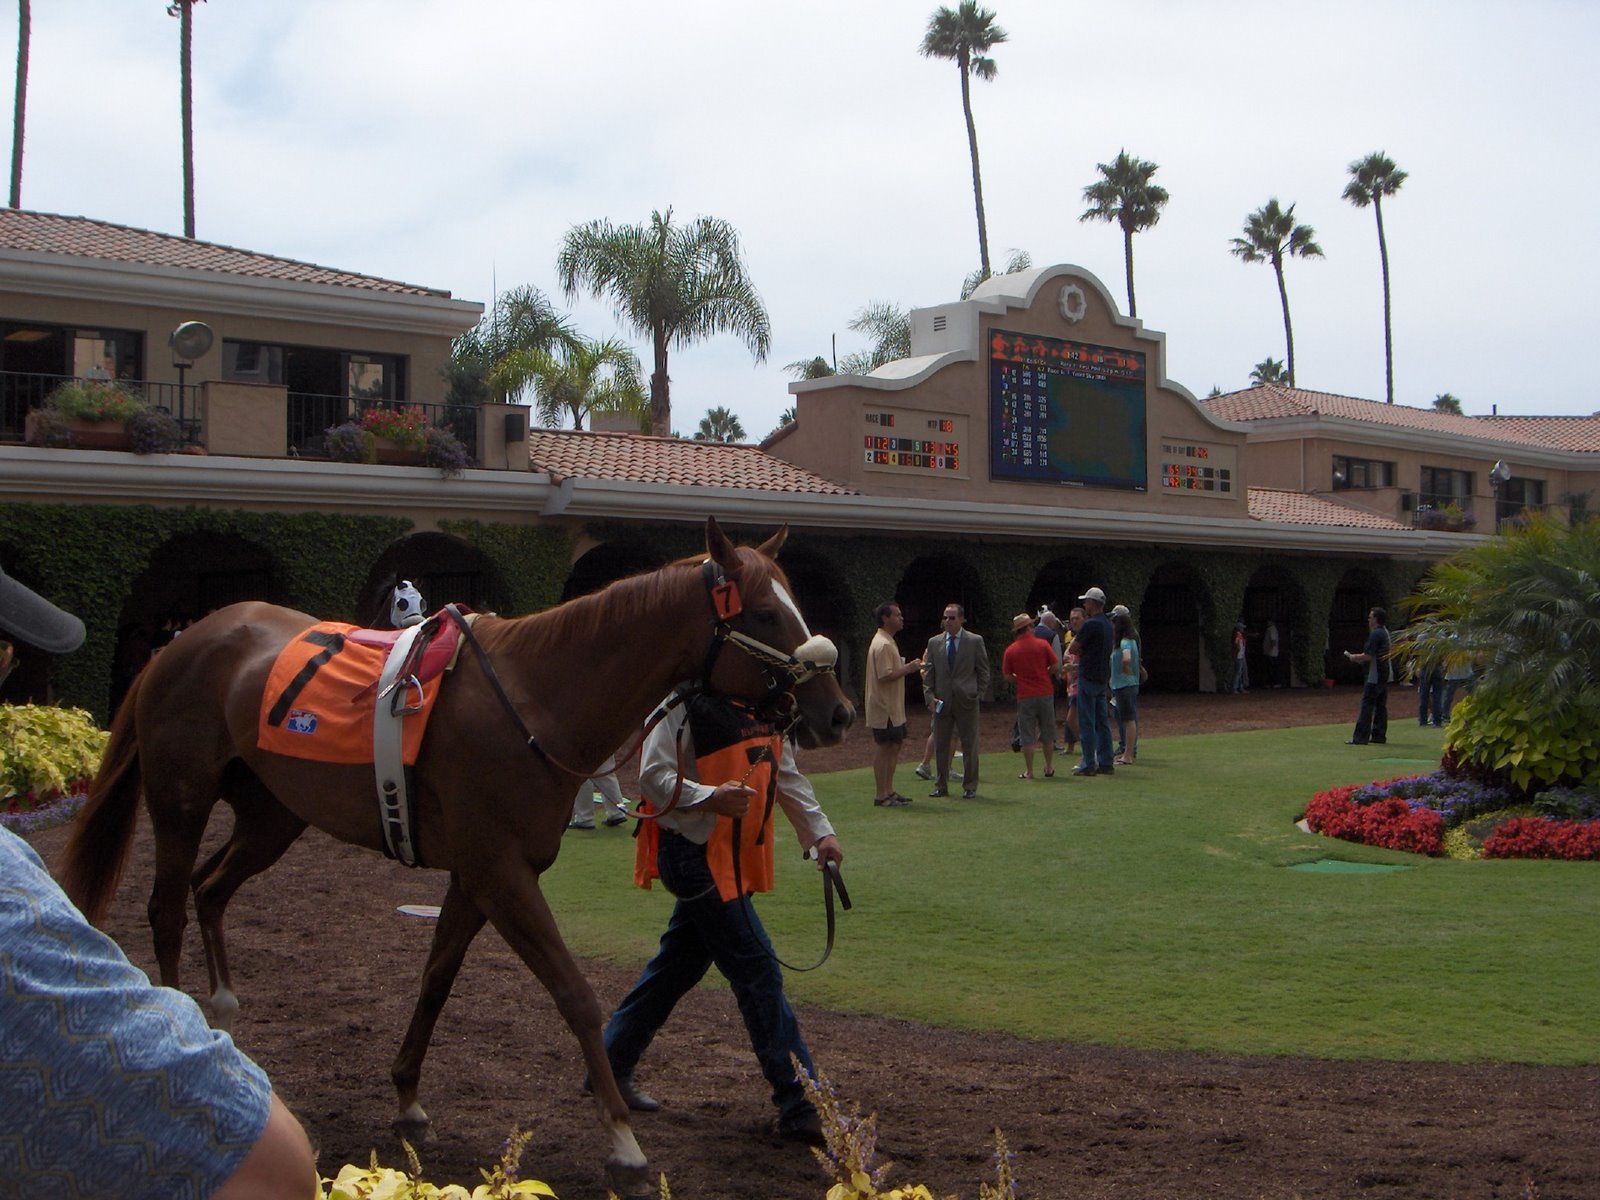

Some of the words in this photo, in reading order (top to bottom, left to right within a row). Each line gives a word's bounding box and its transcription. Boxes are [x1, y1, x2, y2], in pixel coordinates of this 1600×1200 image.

[865, 413, 879, 423] RACE
[867, 437, 871, 447] 1
[877, 437, 888, 450] 12
[890, 439, 896, 450] 3
[915, 441, 920, 451] 5
[866, 452, 872, 462] 2
[877, 452, 888, 464] 14
[715, 586, 731, 614] 7
[267, 630, 346, 728] 7
[745, 744, 779, 846] 7
